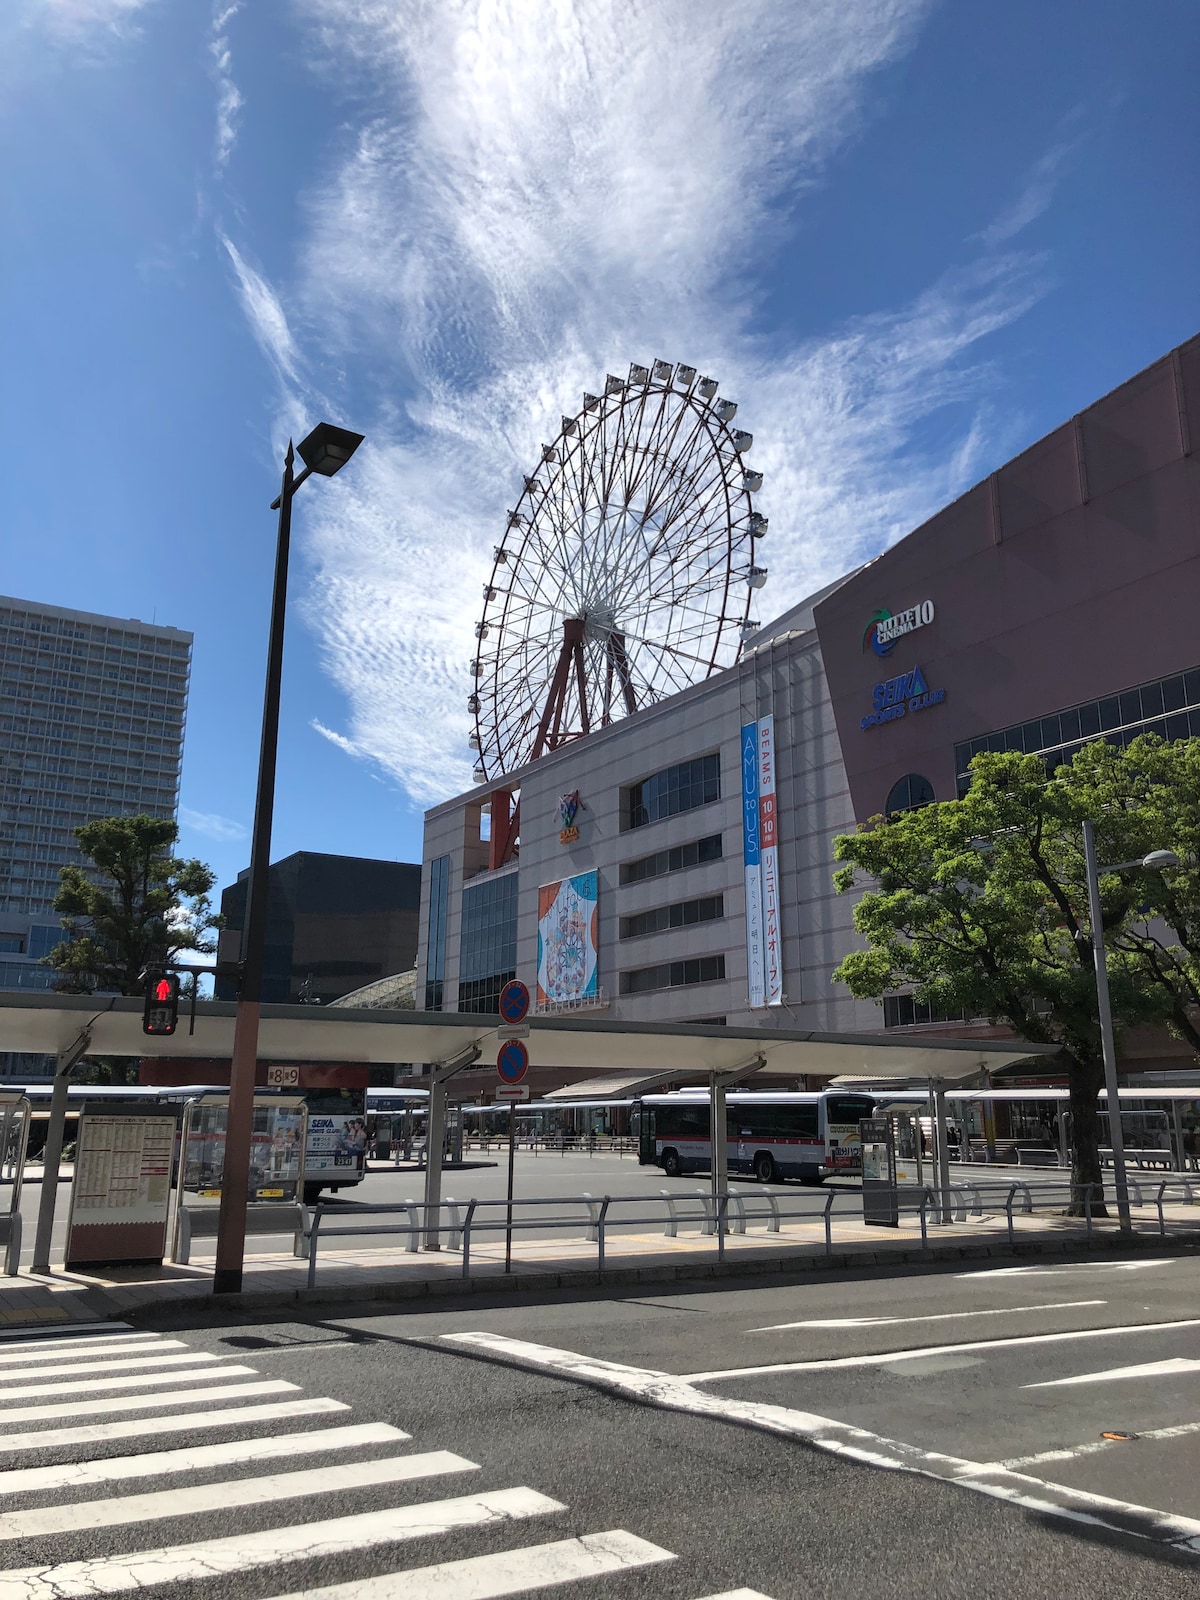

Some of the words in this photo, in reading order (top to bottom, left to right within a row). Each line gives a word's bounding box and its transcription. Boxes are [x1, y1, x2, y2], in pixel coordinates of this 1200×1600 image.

[877, 622, 914, 644] CINEMA
[913, 599, 935, 628] 10
[877, 610, 913, 634] MITTE
[860, 703, 906, 731] SPORTS
[908, 688, 946, 712] CLUB
[872, 664, 928, 711] SEIKA
[743, 736, 756, 795] AMU
[761, 728, 771, 785] BEAMS
[745, 798, 756, 811] to
[765, 854, 780, 998] リニューアルオープン
[312, 1117, 334, 1128] SEIKA
